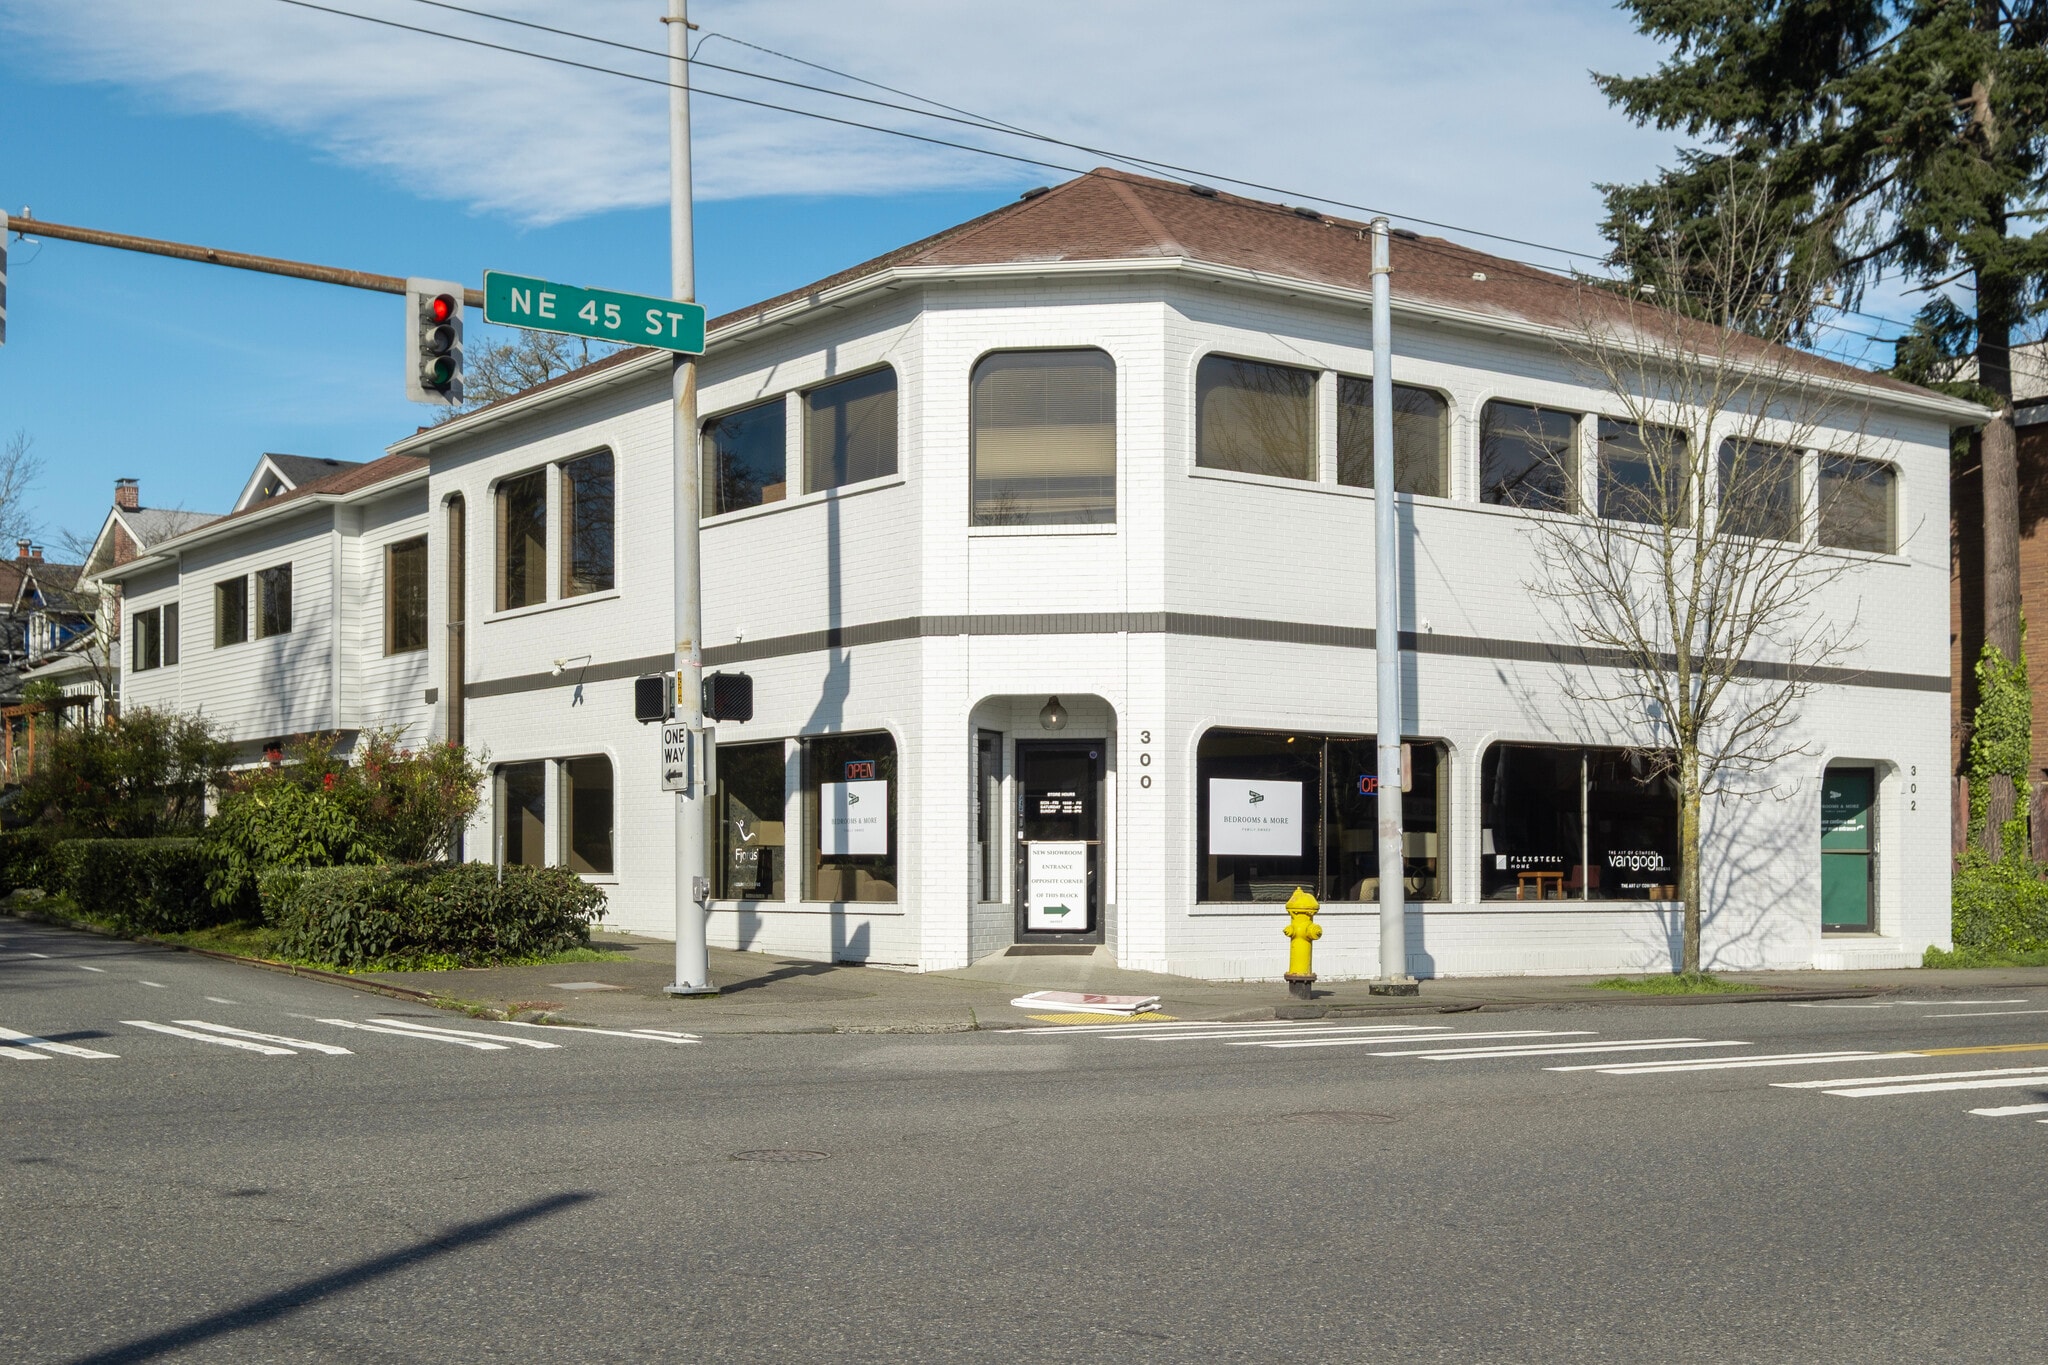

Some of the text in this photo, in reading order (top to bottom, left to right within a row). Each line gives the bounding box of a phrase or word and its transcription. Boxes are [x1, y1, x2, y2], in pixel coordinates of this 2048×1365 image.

[511, 287, 683, 338] NE 45 ST
[664, 728, 685, 744] ONE
[664, 747, 685, 763] WAY
[1140, 730, 1152, 789] 300
[847, 763, 873, 779] OPEN
[1362, 777, 1378, 793] OP
[1223, 815, 1261, 824] BEDROOMS
[1270, 817, 1289, 825] MORE
[1608, 852, 1663, 871] vangogh
